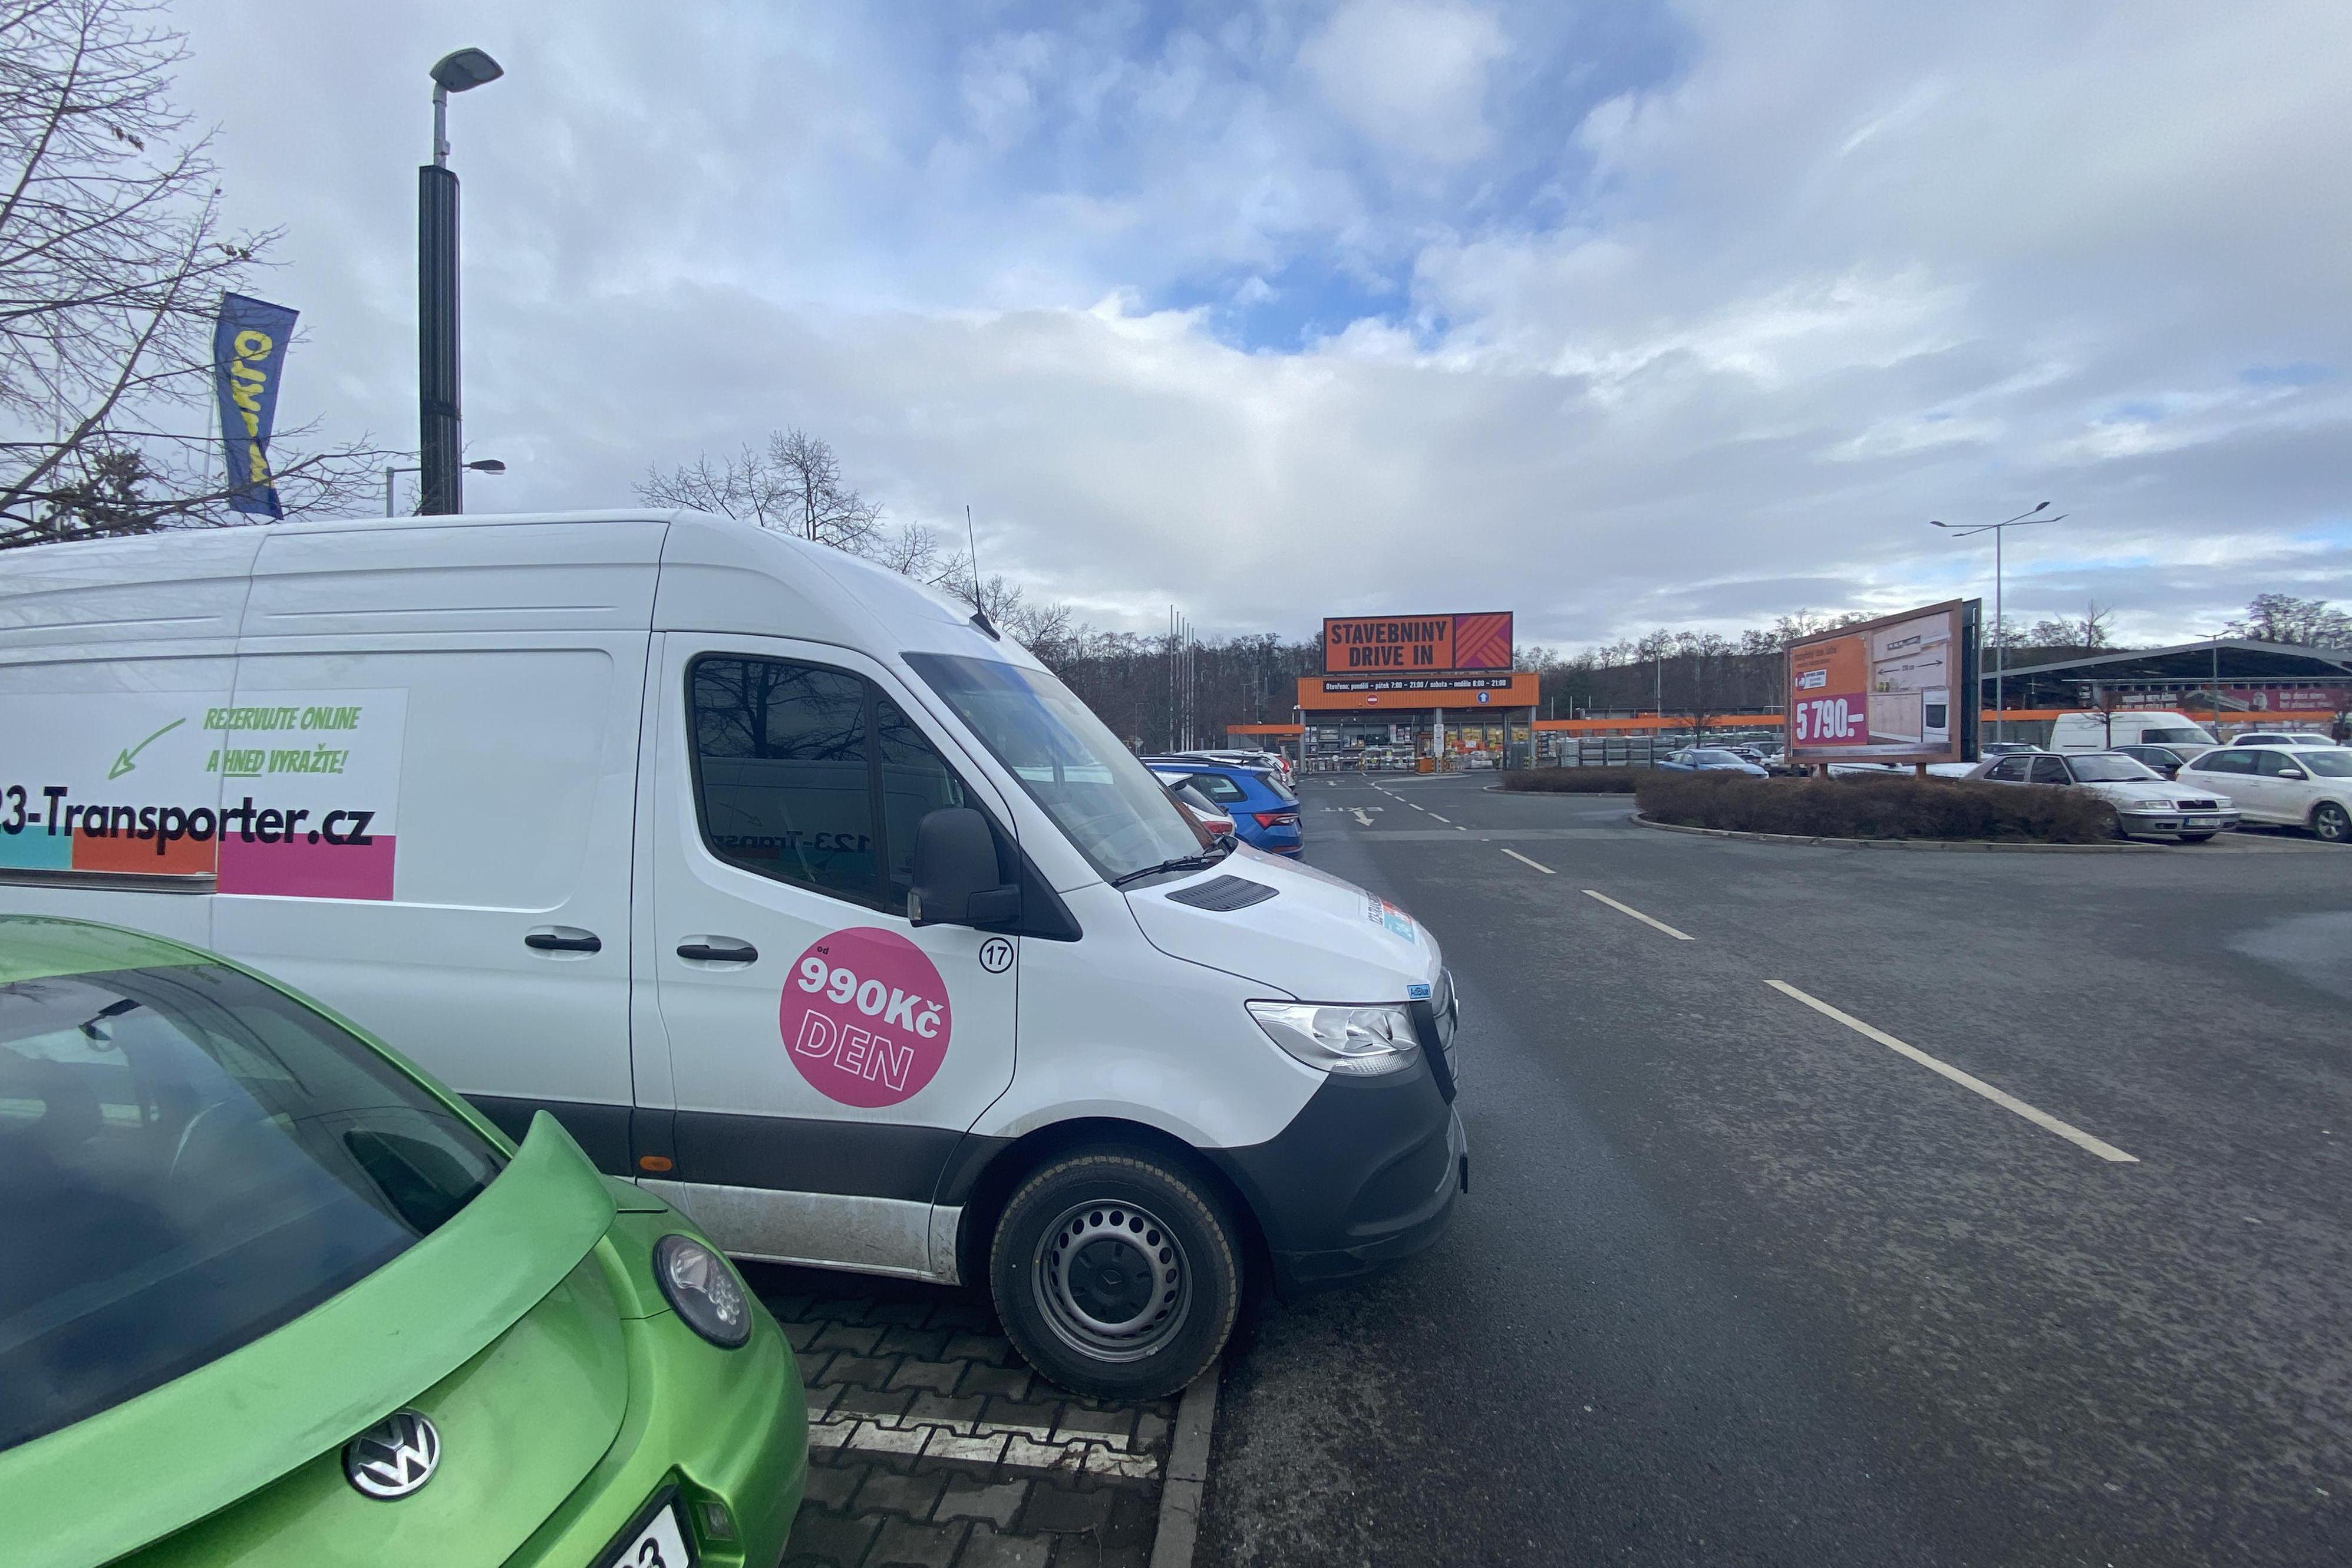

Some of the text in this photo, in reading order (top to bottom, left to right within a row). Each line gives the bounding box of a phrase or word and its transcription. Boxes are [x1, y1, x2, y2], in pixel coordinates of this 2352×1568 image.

[1331, 621, 1447, 645] STAVEBNINY
[1350, 645, 1433, 667] DRIVE IN
[203, 707, 362, 730] REZERVUJTE ONLINE
[206, 742, 349, 774] A HNED VYRAŽTE!
[0, 785, 375, 856] 3-Transporter.cz
[817, 946, 830, 955] od
[987, 945, 1008, 965] 17
[798, 957, 944, 1038] 990Kč
[1410, 987, 1429, 996] AdBlue
[796, 1009, 914, 1091] DEN
